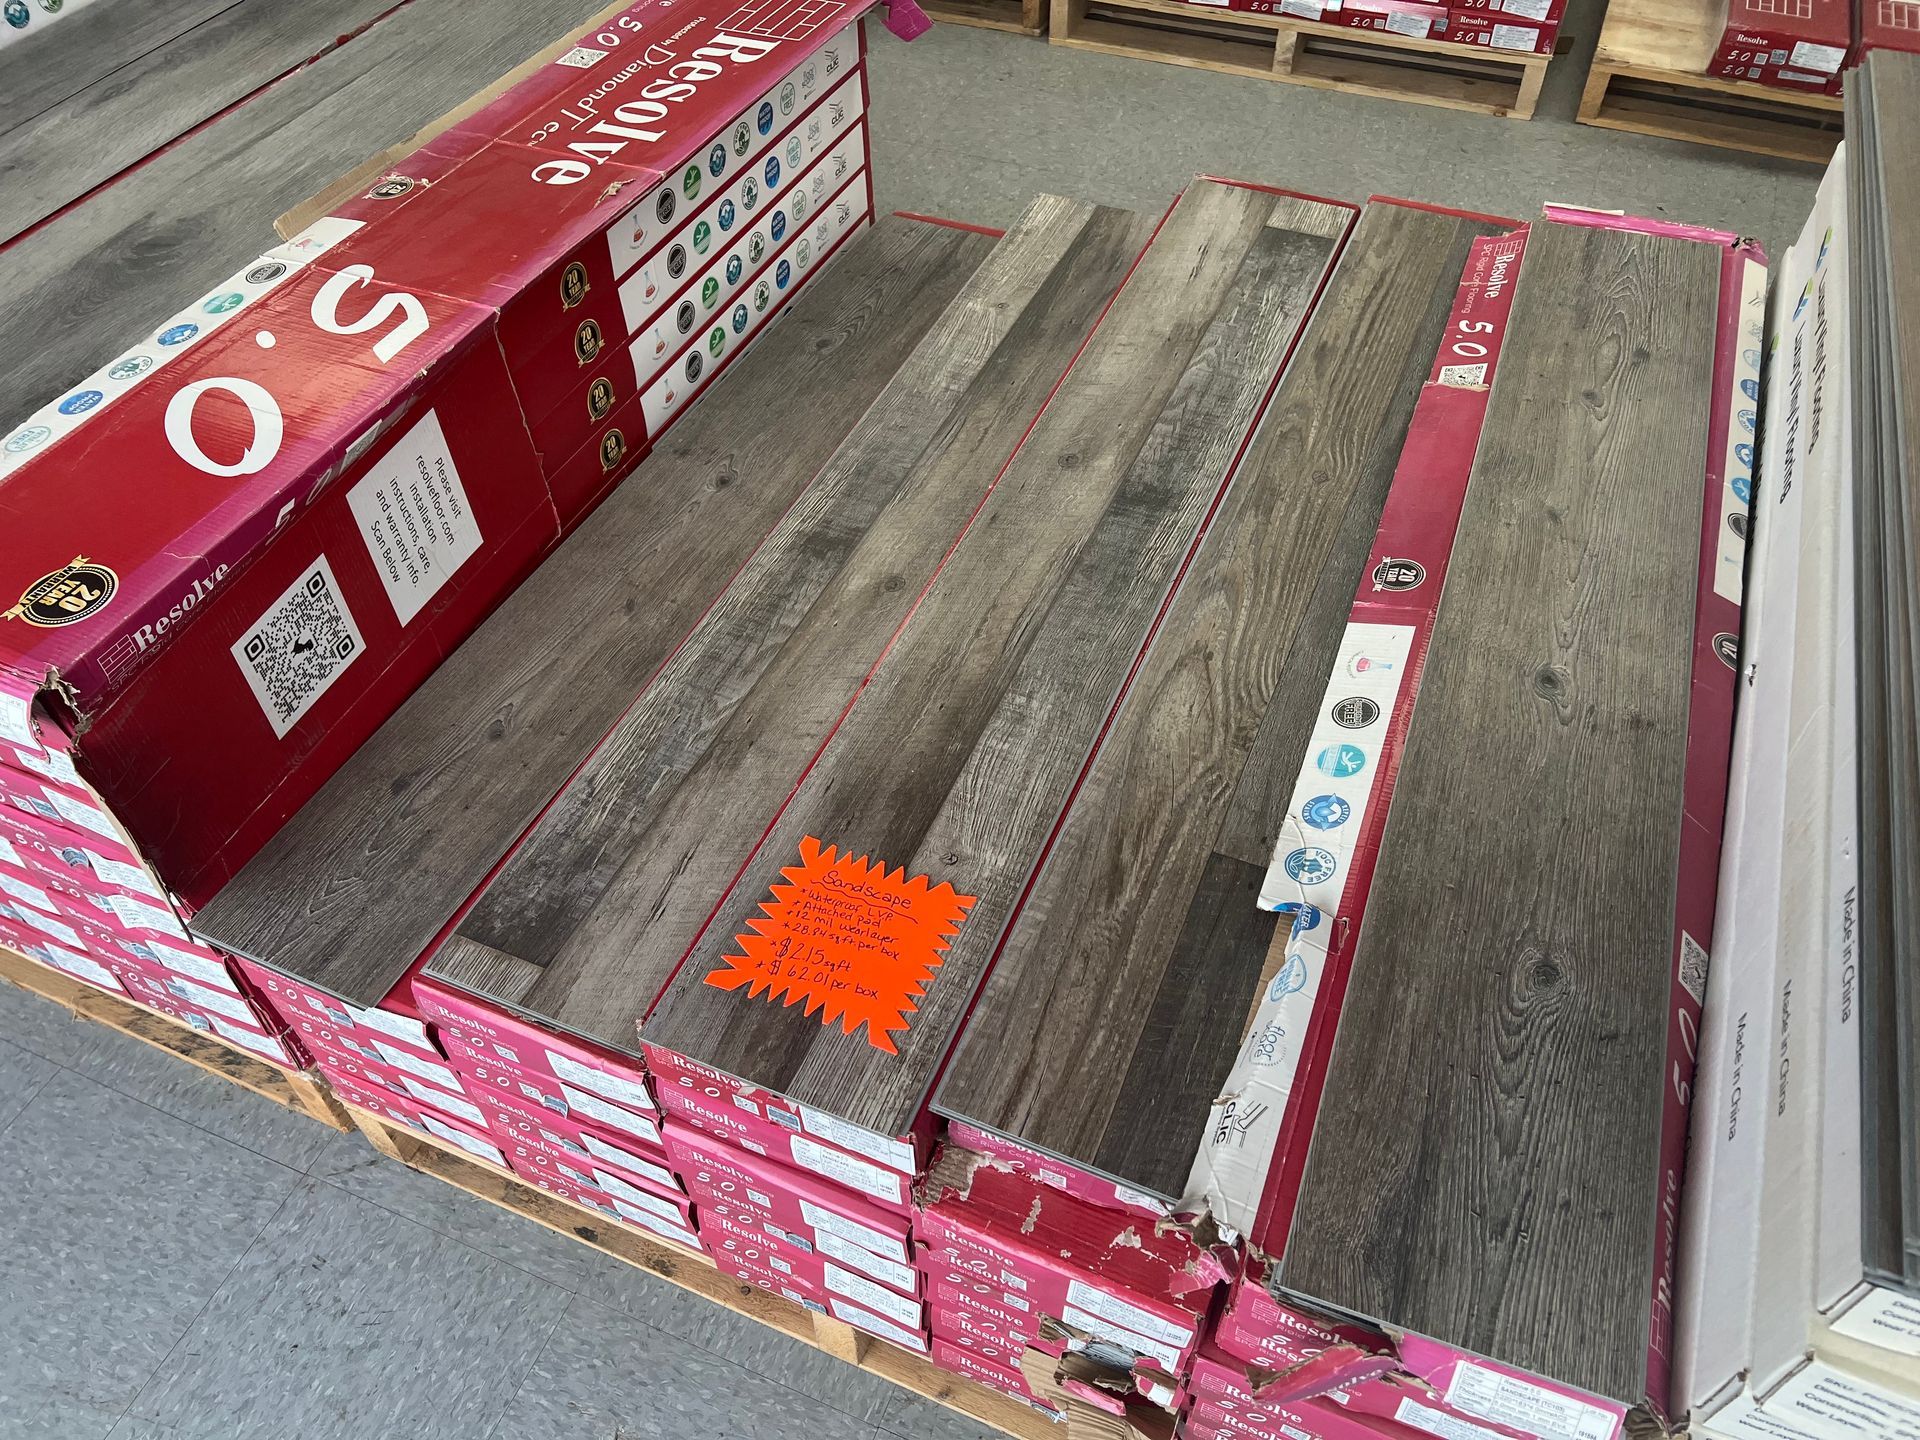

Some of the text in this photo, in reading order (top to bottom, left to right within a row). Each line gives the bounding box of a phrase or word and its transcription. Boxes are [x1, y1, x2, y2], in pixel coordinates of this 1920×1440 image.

[1250, 2, 1269, 12] 5.0
[596, 16, 643, 47] 5.0
[1351, 17, 1371, 28] 5.0
[1460, 16, 1489, 26] Resolve
[1454, 31, 1475, 42] 5.0
[1737, 33, 1768, 46] Resolve
[826, 58, 839, 73] CLIC
[1727, 50, 1751, 61] 5.0
[1722, 65, 1745, 76] 5.0
[531, 32, 782, 186] Resolve
[831, 109, 844, 125] CLIC
[1481, 243, 1493, 256] SPC
[1476, 257, 1489, 271] Rigid
[1484, 253, 1516, 299] Resolve
[567, 269, 579, 288] 20
[1461, 287, 1479, 314] Flooring
[1815, 268, 1828, 336] Luxury
[581, 326, 592, 345] 20
[1452, 319, 1494, 357] 5.0
[1790, 320, 1806, 386] Luxury
[165, 263, 430, 478] 5.0
[593, 384, 605, 403] 20
[1809, 363, 1827, 455] Flooring
[605, 435, 617, 453] 20
[1780, 416, 1799, 504] Flooring
[415, 454, 455, 546] resolvefloor.com
[434, 457, 462, 520] Please visit
[389, 475, 431, 574] instructions, care,
[409, 481, 437, 544] installation
[375, 489, 419, 588] and warranty info.
[370, 520, 401, 583] Scan Below
[20, 565, 77, 608] WARRANTY
[1385, 567, 1400, 582] YEAR
[1398, 568, 1417, 582] 20
[38, 579, 81, 606] YEAR
[58, 584, 101, 613] 20
[131, 562, 230, 655] Resolve
[1304, 800, 1316, 821] STAINS
[1337, 803, 1349, 824] REPELS
[15, 833, 46, 852] 5.0
[1307, 850, 1332, 883] VOC FREE
[51, 880, 81, 898] 5.0
[822, 870, 912, 909] Sandscape
[796, 911, 810, 921] 12
[814, 916, 833, 928] mil
[803, 901, 881, 928] Attached pad
[82, 925, 111, 943] 5.0
[858, 941, 877, 951] per
[881, 945, 900, 961] box
[1841, 886, 1857, 1024] Made in China
[110, 965, 139, 982] 5.0
[267, 979, 298, 1000] 5.0
[830, 977, 850, 992] per
[855, 984, 879, 999] box
[148, 998, 175, 1016] 5.0
[289, 1003, 340, 1031] Resolve
[301, 1022, 332, 1040] 5.0
[438, 1005, 497, 1037] Resolve
[450, 1027, 485, 1047] 5.0
[1265, 1025, 1286, 1061] floor
[1778, 979, 1792, 1117] Made in China
[328, 1056, 358, 1073] 5.0
[465, 1046, 523, 1077] Resolve
[671, 1055, 742, 1089] Resolve
[475, 1067, 510, 1087] 5.0
[678, 1076, 721, 1098] 5.0
[1728, 1011, 1748, 1142] Made in China
[351, 1093, 380, 1110] 5.0
[487, 1095, 543, 1124] Resolve
[498, 1113, 531, 1131] 5.0
[683, 1097, 748, 1133] Resolve
[1216, 1101, 1236, 1144] CLIC
[690, 1119, 729, 1139] 5.0
[508, 1127, 559, 1157] Resolve
[516, 1146, 548, 1165] 5.0
[691, 1151, 754, 1183] Resolve
[957, 1131, 978, 1143] SPC
[980, 1140, 1006, 1153] Rigid
[1008, 1149, 1032, 1161] Core
[1034, 1158, 1076, 1179] Flooring
[539, 1180, 569, 1197] 5.0
[696, 1171, 736, 1192] 5.0
[711, 1189, 772, 1219] Resolve
[715, 1205, 753, 1224] 5.0
[721, 1218, 778, 1251] Resolve
[1658, 1168, 1677, 1309] Resolve
[722, 1240, 759, 1259] 5.0
[943, 1229, 1015, 1267] Resolve
[733, 1255, 789, 1284] Resolve
[736, 1270, 772, 1288] 5.0
[945, 1273, 991, 1294] 5.0
[957, 1292, 1024, 1327] Resolve
[960, 1319, 1023, 1354] Resolve
[1251, 1312, 1307, 1340] SPC Rigid
[957, 1337, 998, 1356] 5.0
[960, 1356, 1021, 1389] Resolve
[1501, 1386, 1540, 1405] SANDSCAPE
[1215, 1400, 1267, 1422] 5.0
